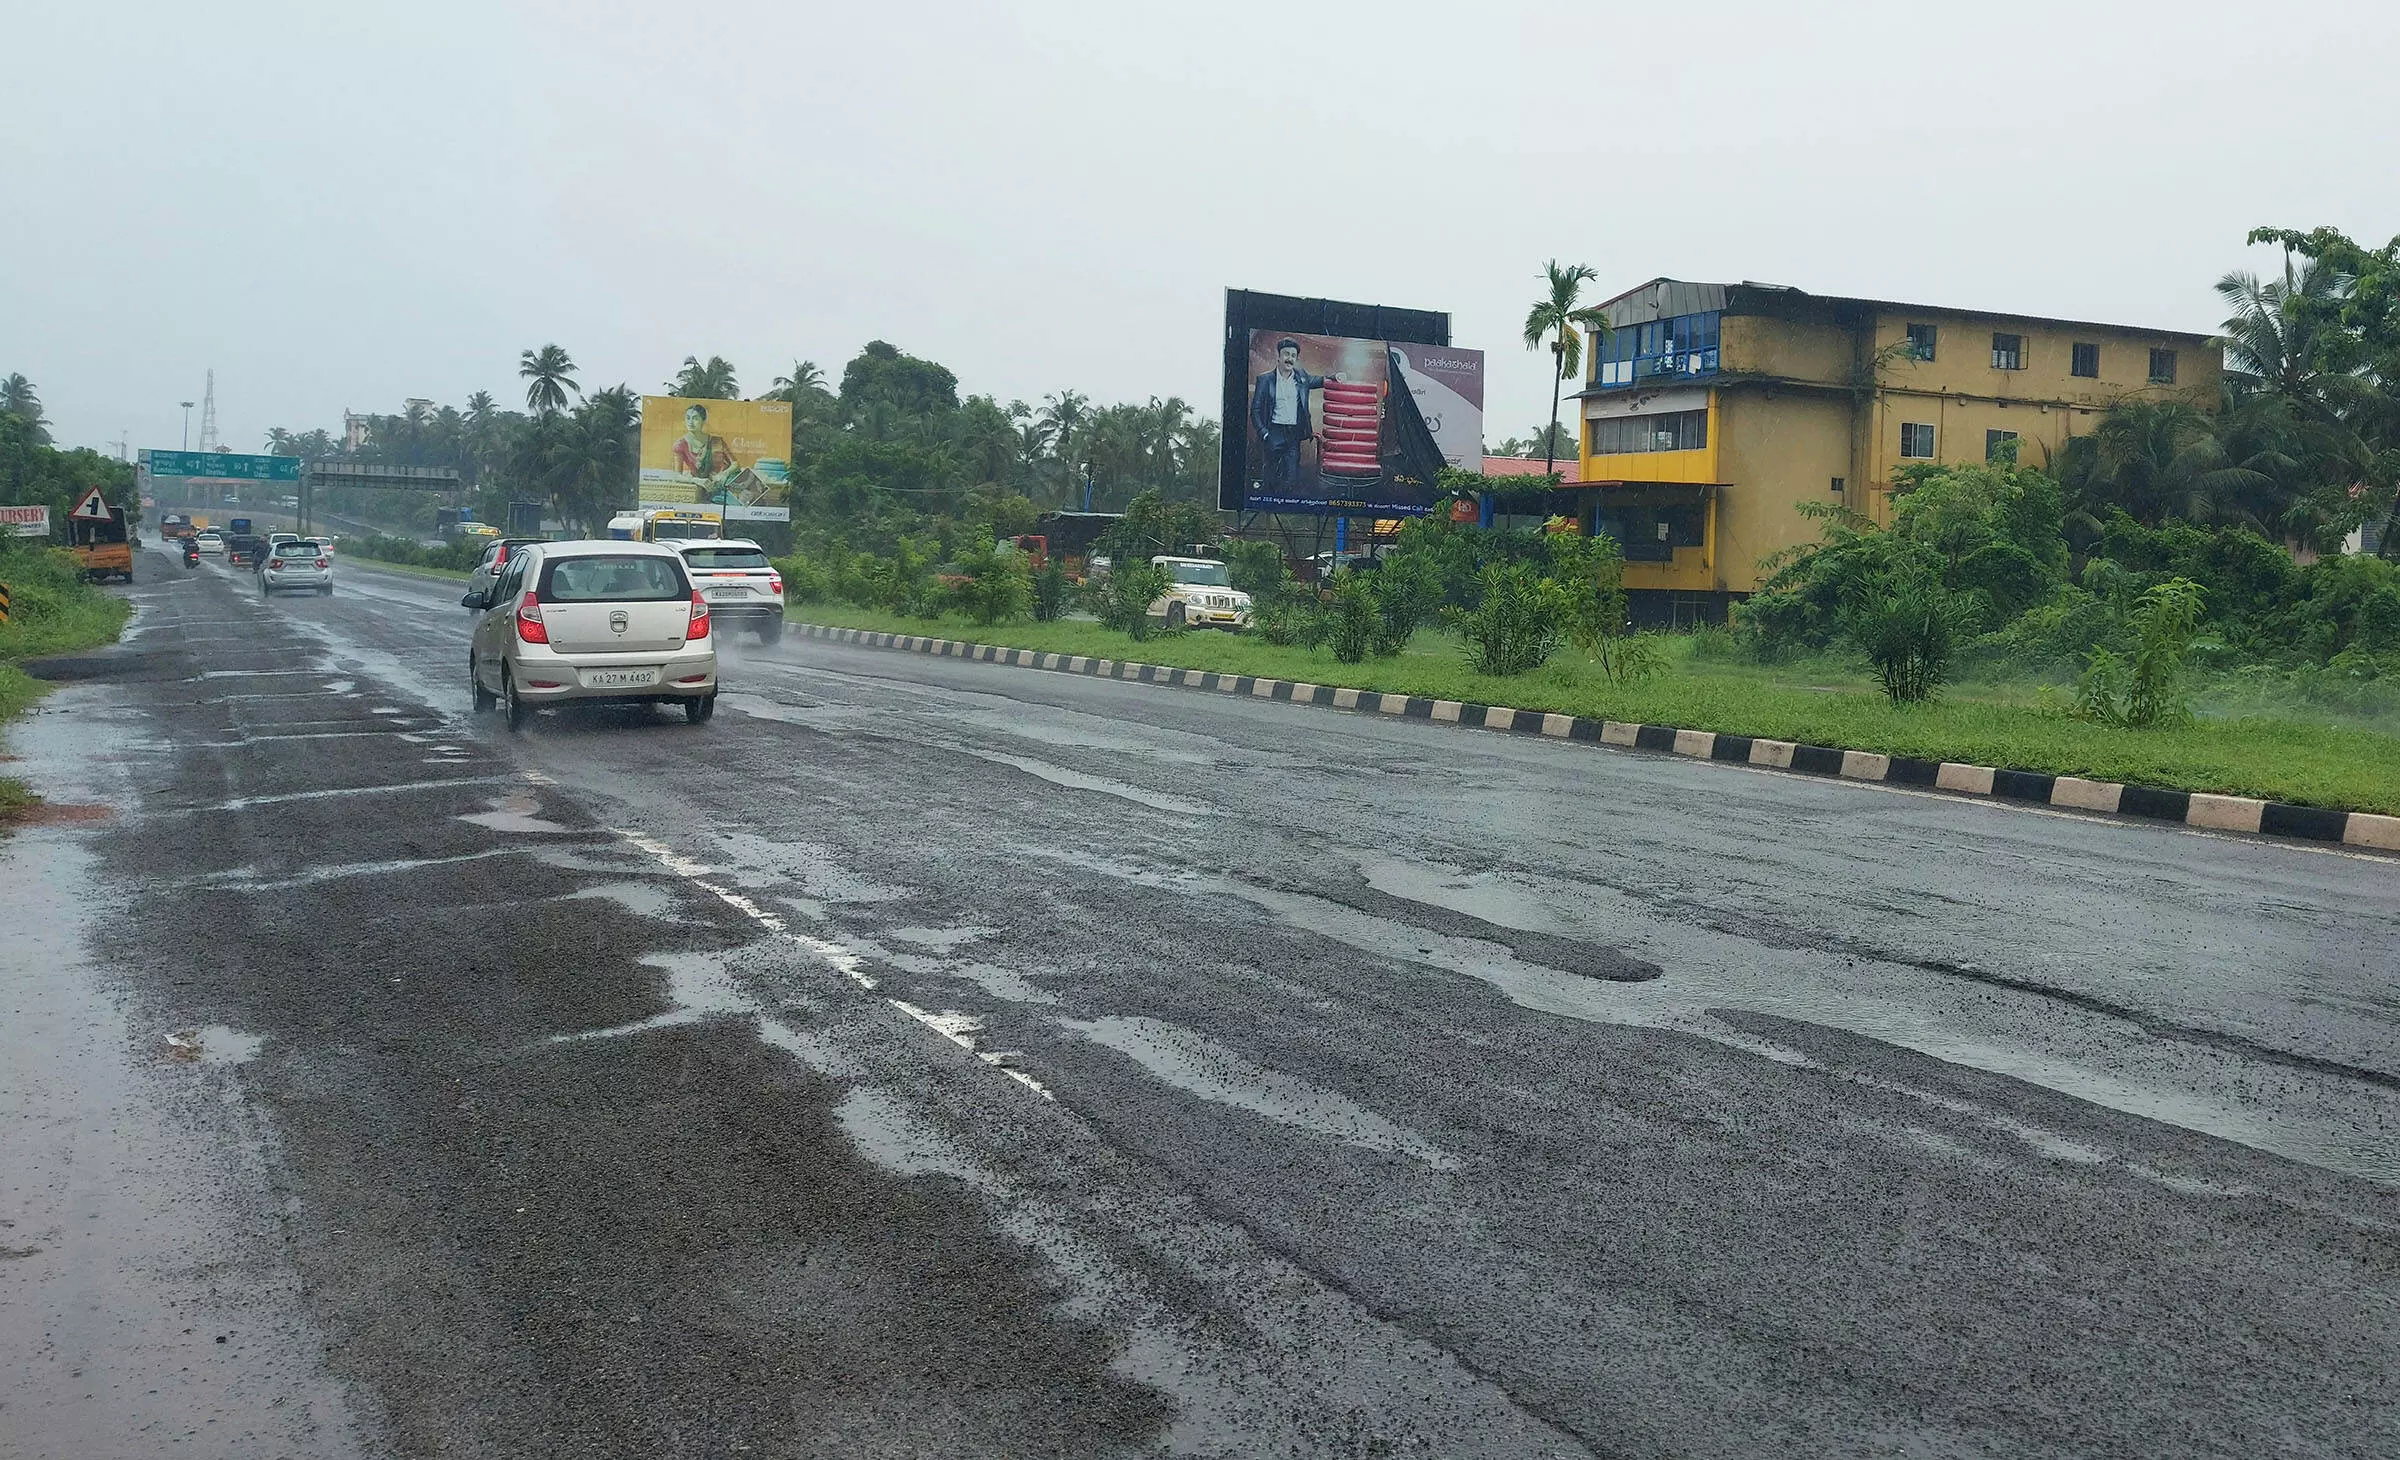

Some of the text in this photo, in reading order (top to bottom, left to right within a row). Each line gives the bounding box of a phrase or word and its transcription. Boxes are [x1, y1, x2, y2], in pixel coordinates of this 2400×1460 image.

[592, 673, 651, 683] KA 27 M 4432
